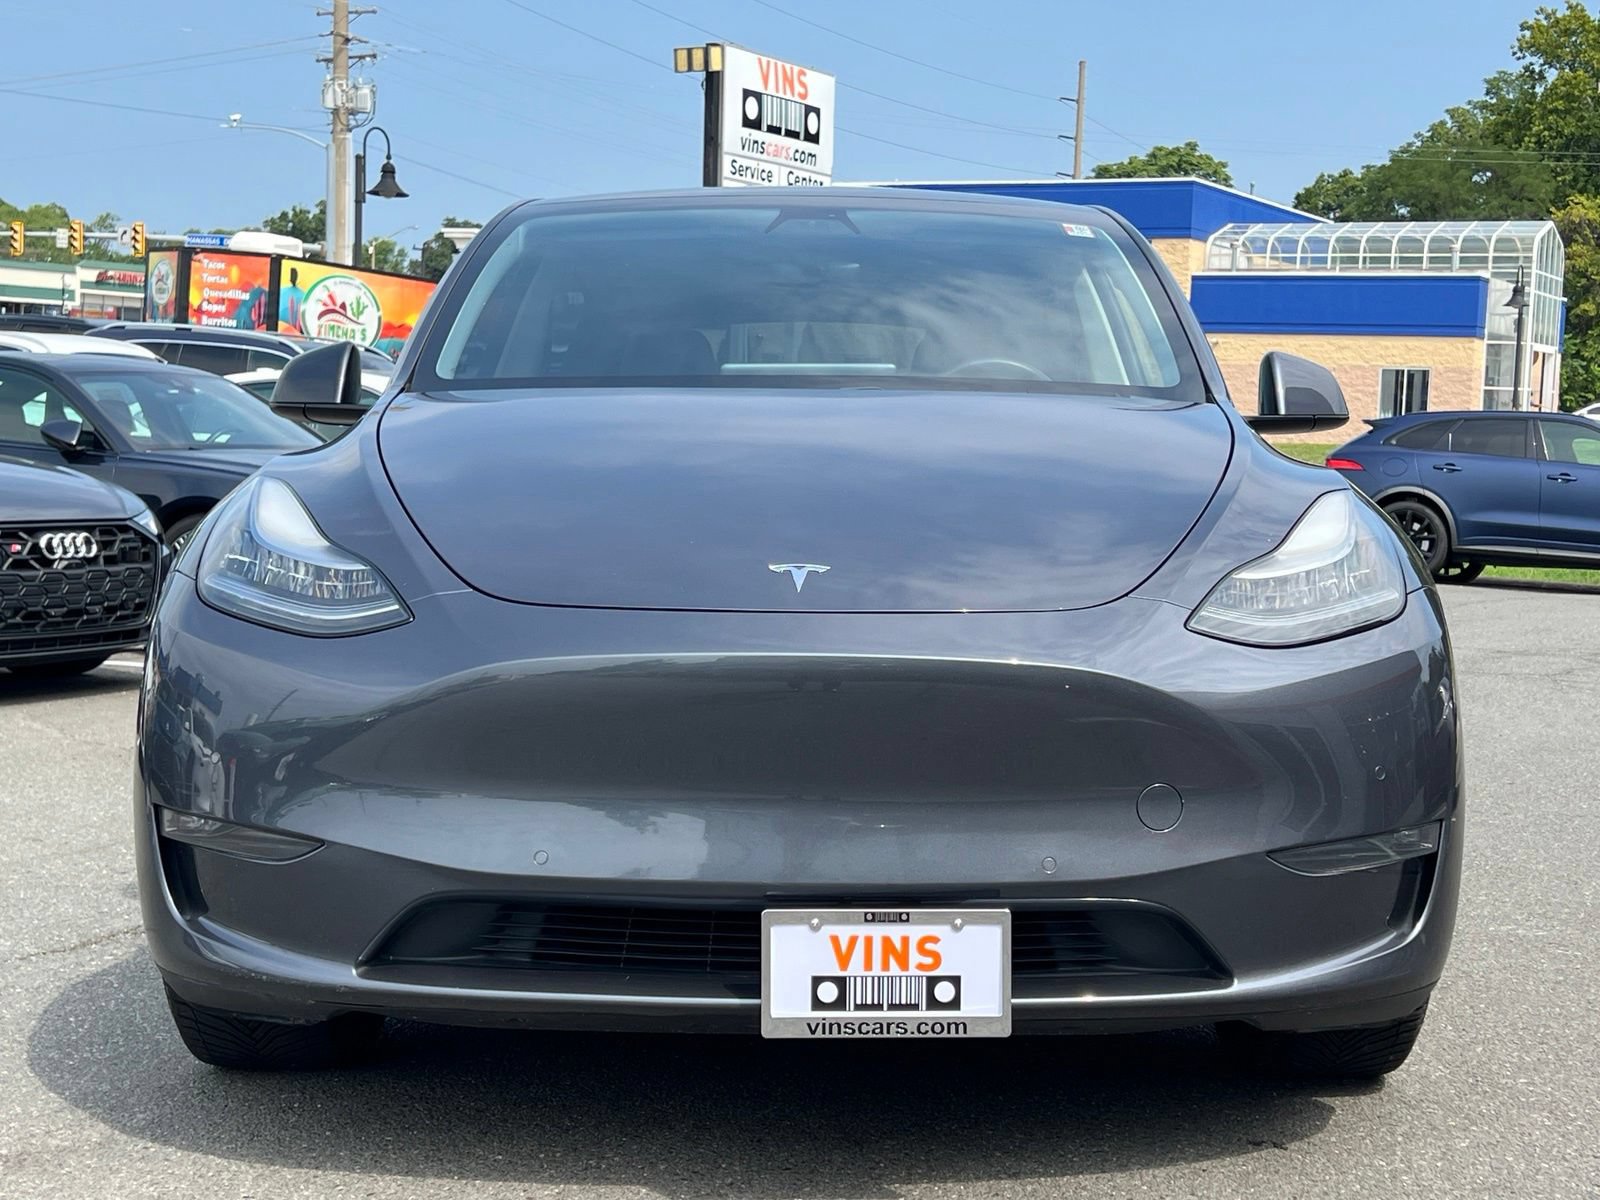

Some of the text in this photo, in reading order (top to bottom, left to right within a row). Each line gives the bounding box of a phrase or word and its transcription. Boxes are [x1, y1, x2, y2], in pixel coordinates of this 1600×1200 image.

[757, 56, 809, 101] VINS
[740, 133, 817, 167] vinscars.com
[729, 159, 774, 183] Service
[203, 259, 226, 270] Tacos
[202, 273, 229, 284] Tortas
[203, 288, 251, 301] Quesadillas
[201, 301, 227, 313] Sopes
[201, 315, 238, 328] Burritos
[829, 934, 943, 972] VINS
[806, 1018, 968, 1036] vinscars.com
